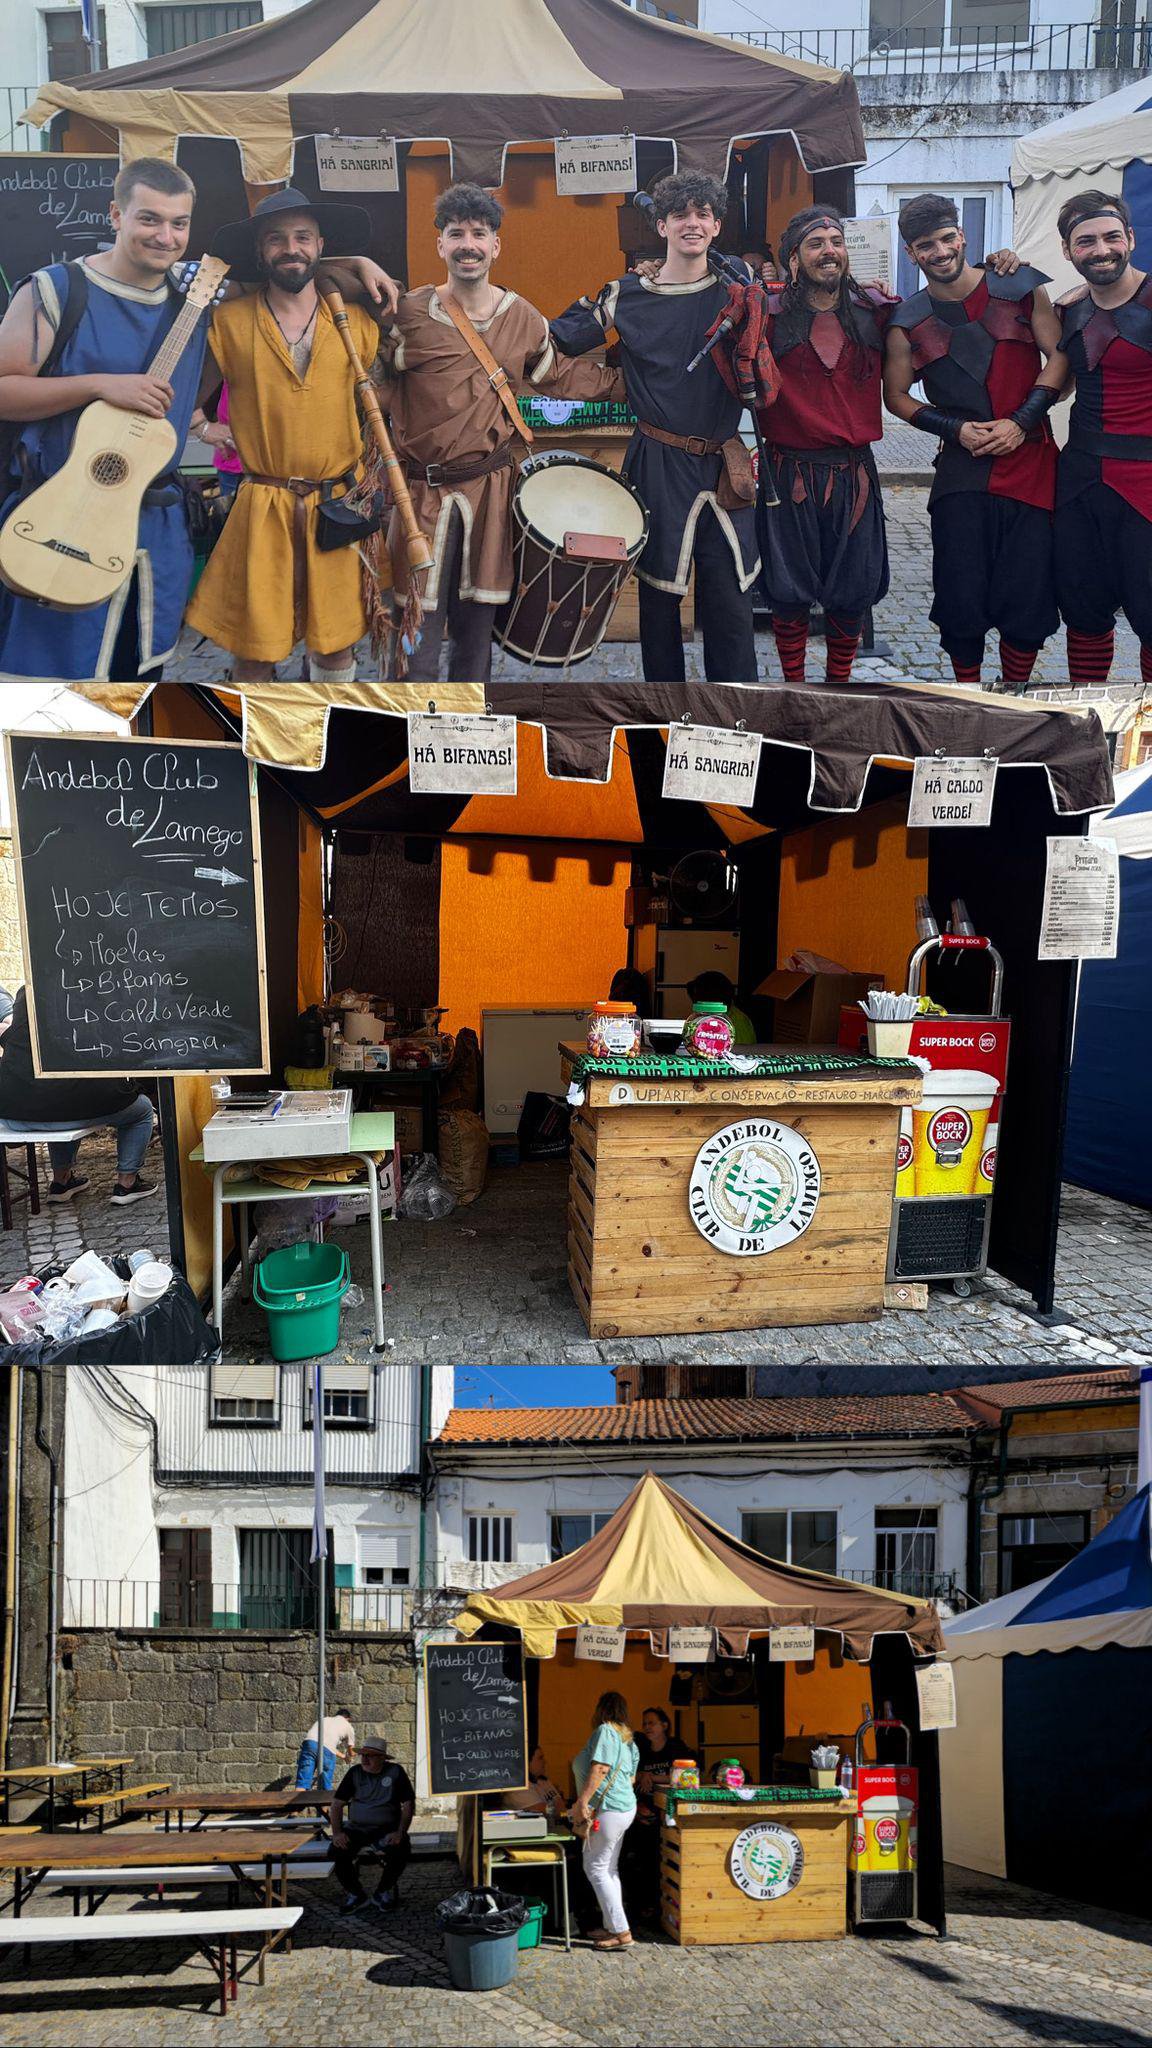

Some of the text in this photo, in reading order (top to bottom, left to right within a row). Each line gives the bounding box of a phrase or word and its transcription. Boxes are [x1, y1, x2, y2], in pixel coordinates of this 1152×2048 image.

[320, 156, 394, 170] HÁ SANGRIA!
[560, 157, 632, 174] HÁ BIFANAS!
[0, 167, 58, 191] ndebol
[39, 193, 113, 229] de Lame
[414, 743, 511, 765] HÁ BIFANAS!
[669, 751, 754, 777] HÁ SANGRIA!
[21, 751, 218, 790] Andebol Club
[924, 776, 983, 793] HÁ CALDO
[932, 803, 972, 819] VERDE!
[105, 795, 243, 856] de Lamego
[51, 886, 239, 923] HOJE TEMOS
[89, 928, 165, 965] Moelas
[98, 968, 189, 995] Bifanas
[104, 998, 171, 1024] Caldo
[919, 1037, 974, 1047] SUPER BOCK
[805, 1090, 857, 1101] RESTAURO
[935, 1121, 964, 1132] SUPER
[936, 1130, 962, 1140] BOCK
[700, 1124, 784, 1171] ANDEBOL
[789, 1151, 818, 1232] LAMEGO
[691, 1186, 720, 1238] CLUB
[737, 1238, 765, 1251] DE
[462, 1667, 479, 1683] de
[463, 1728, 514, 1744] BIFANAS
